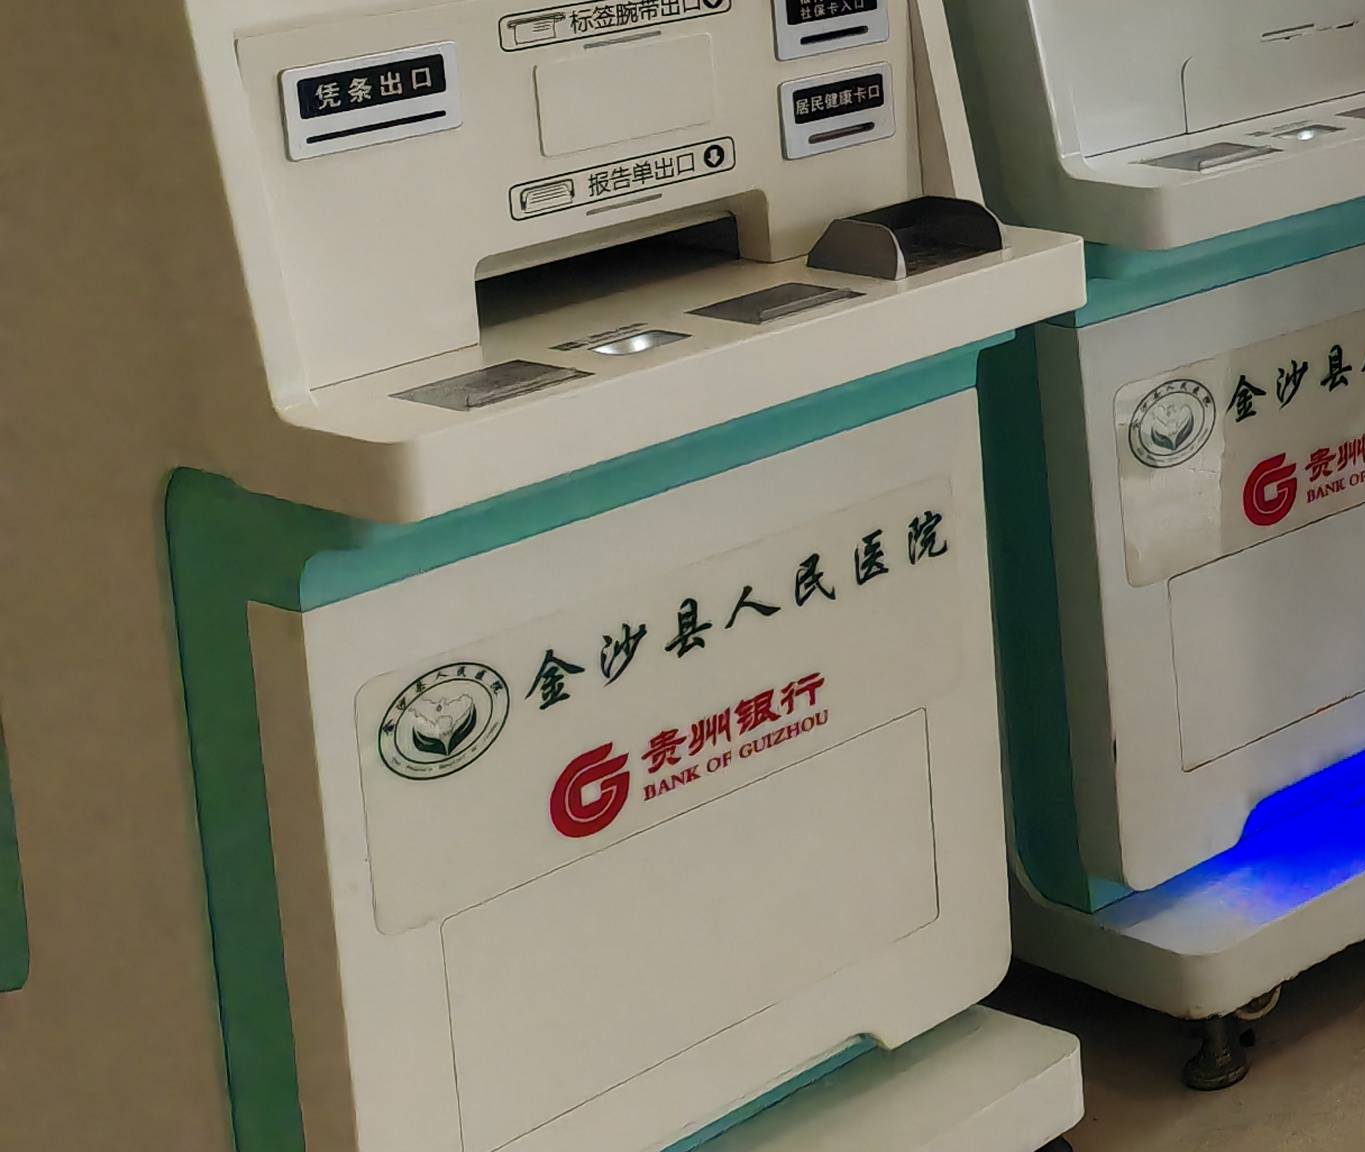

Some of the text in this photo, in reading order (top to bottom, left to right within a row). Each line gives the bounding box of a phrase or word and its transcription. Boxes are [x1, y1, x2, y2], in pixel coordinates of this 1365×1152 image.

[315, 65, 434, 110] 凭条出口
[796, 84, 880, 115] 居民健康卡口
[588, 152, 696, 198] 报告单出口
[1306, 478, 1346, 504] BANK
[524, 510, 949, 710] 金沙县人民医院
[641, 672, 826, 774] 贵州银行
[643, 709, 830, 803] BANK OF GUIZHOU
